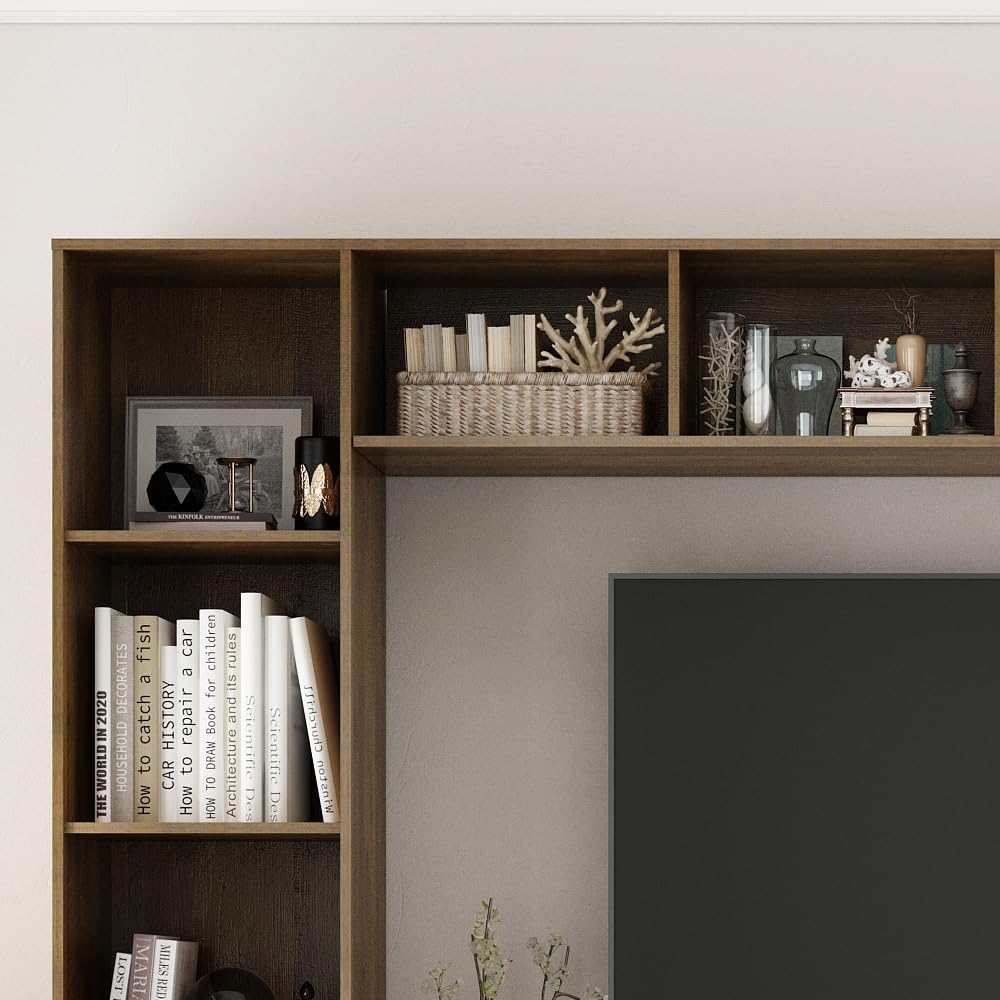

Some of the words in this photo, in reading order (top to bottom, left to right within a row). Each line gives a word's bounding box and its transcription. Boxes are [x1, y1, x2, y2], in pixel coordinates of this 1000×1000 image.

[136, 624, 150, 663] fish
[182, 629, 192, 656] car
[205, 614, 216, 670] children
[226, 633, 236, 668] rules
[116, 643, 128, 714] DECORATES
[140, 675, 150, 683] a
[183, 668, 192, 676] a
[226, 674, 236, 692] its
[205, 679, 216, 698] for
[96, 691, 107, 725] 2020
[137, 695, 150, 744] catch
[162, 681, 174, 750] HISTORY
[179, 688, 196, 744] repair
[206, 706, 216, 734] Book
[227, 697, 236, 723] and
[96, 728, 107, 741] IN
[246, 695, 255, 780] Scientific
[270, 708, 280, 784] Scientific
[96, 745, 107, 792] WORLD
[116, 721, 128, 792] HOUSEHOLD
[138, 755, 150, 774] to
[180, 757, 192, 775] to
[206, 741, 216, 769] DRAW
[162, 761, 174, 790] CAR
[206, 777, 216, 790] TO
[227, 729, 236, 818] Architecture
[96, 794, 107, 818] THE
[137, 785, 150, 814] How
[180, 786, 192, 814] How
[206, 797, 216, 819] HOW
[246, 788, 255, 821] Des
[270, 792, 280, 822] Des
[158, 944, 171, 976] MILES
[115, 958, 127, 994] LOST
